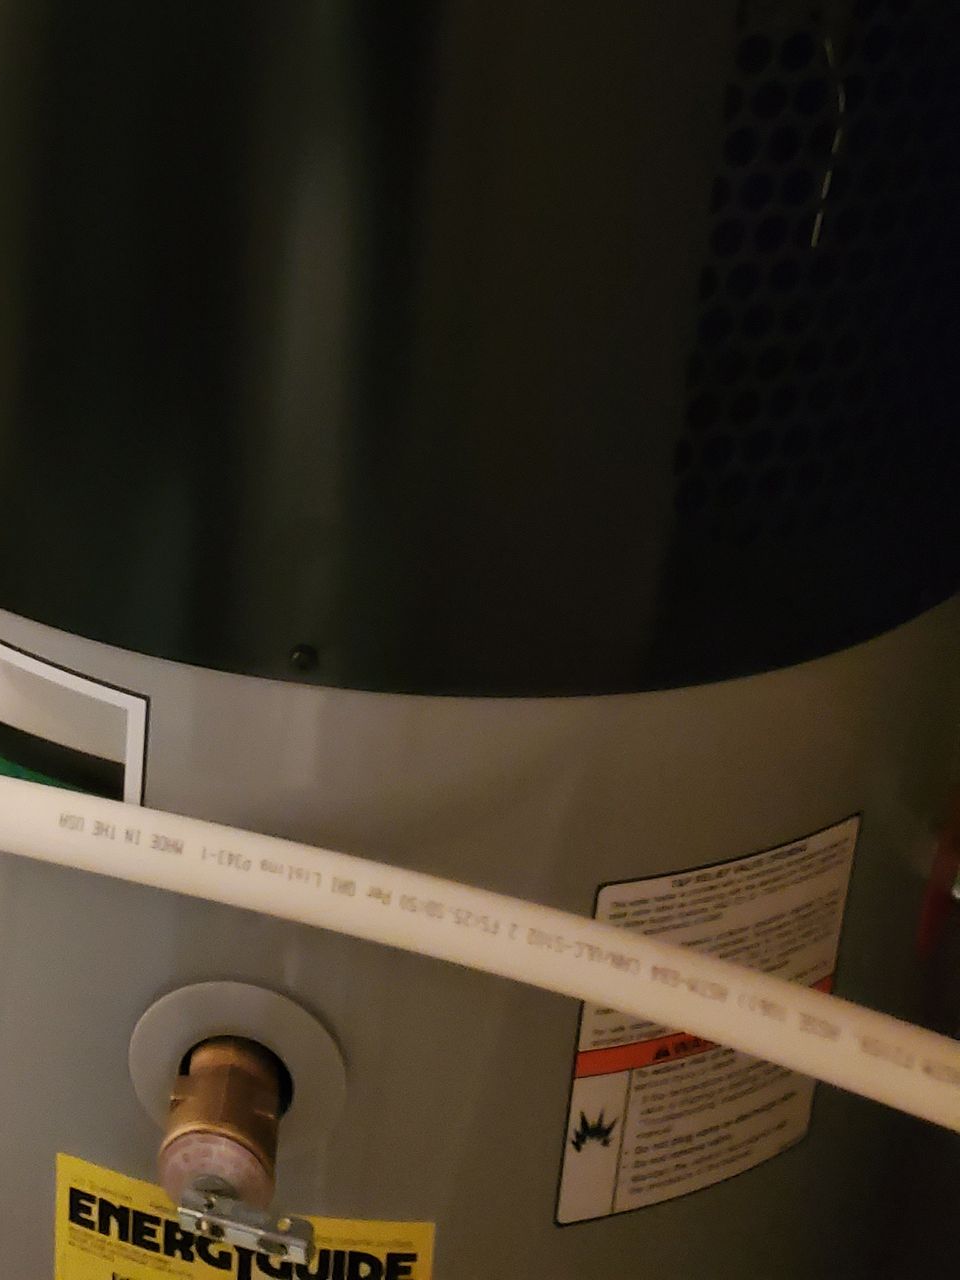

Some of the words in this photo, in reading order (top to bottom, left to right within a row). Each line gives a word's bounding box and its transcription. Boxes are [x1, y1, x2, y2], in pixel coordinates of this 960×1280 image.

[58, 813, 85, 832] USA
[92, 820, 116, 841] THE
[124, 829, 141, 846] IN
[151, 834, 185, 856] MADE
